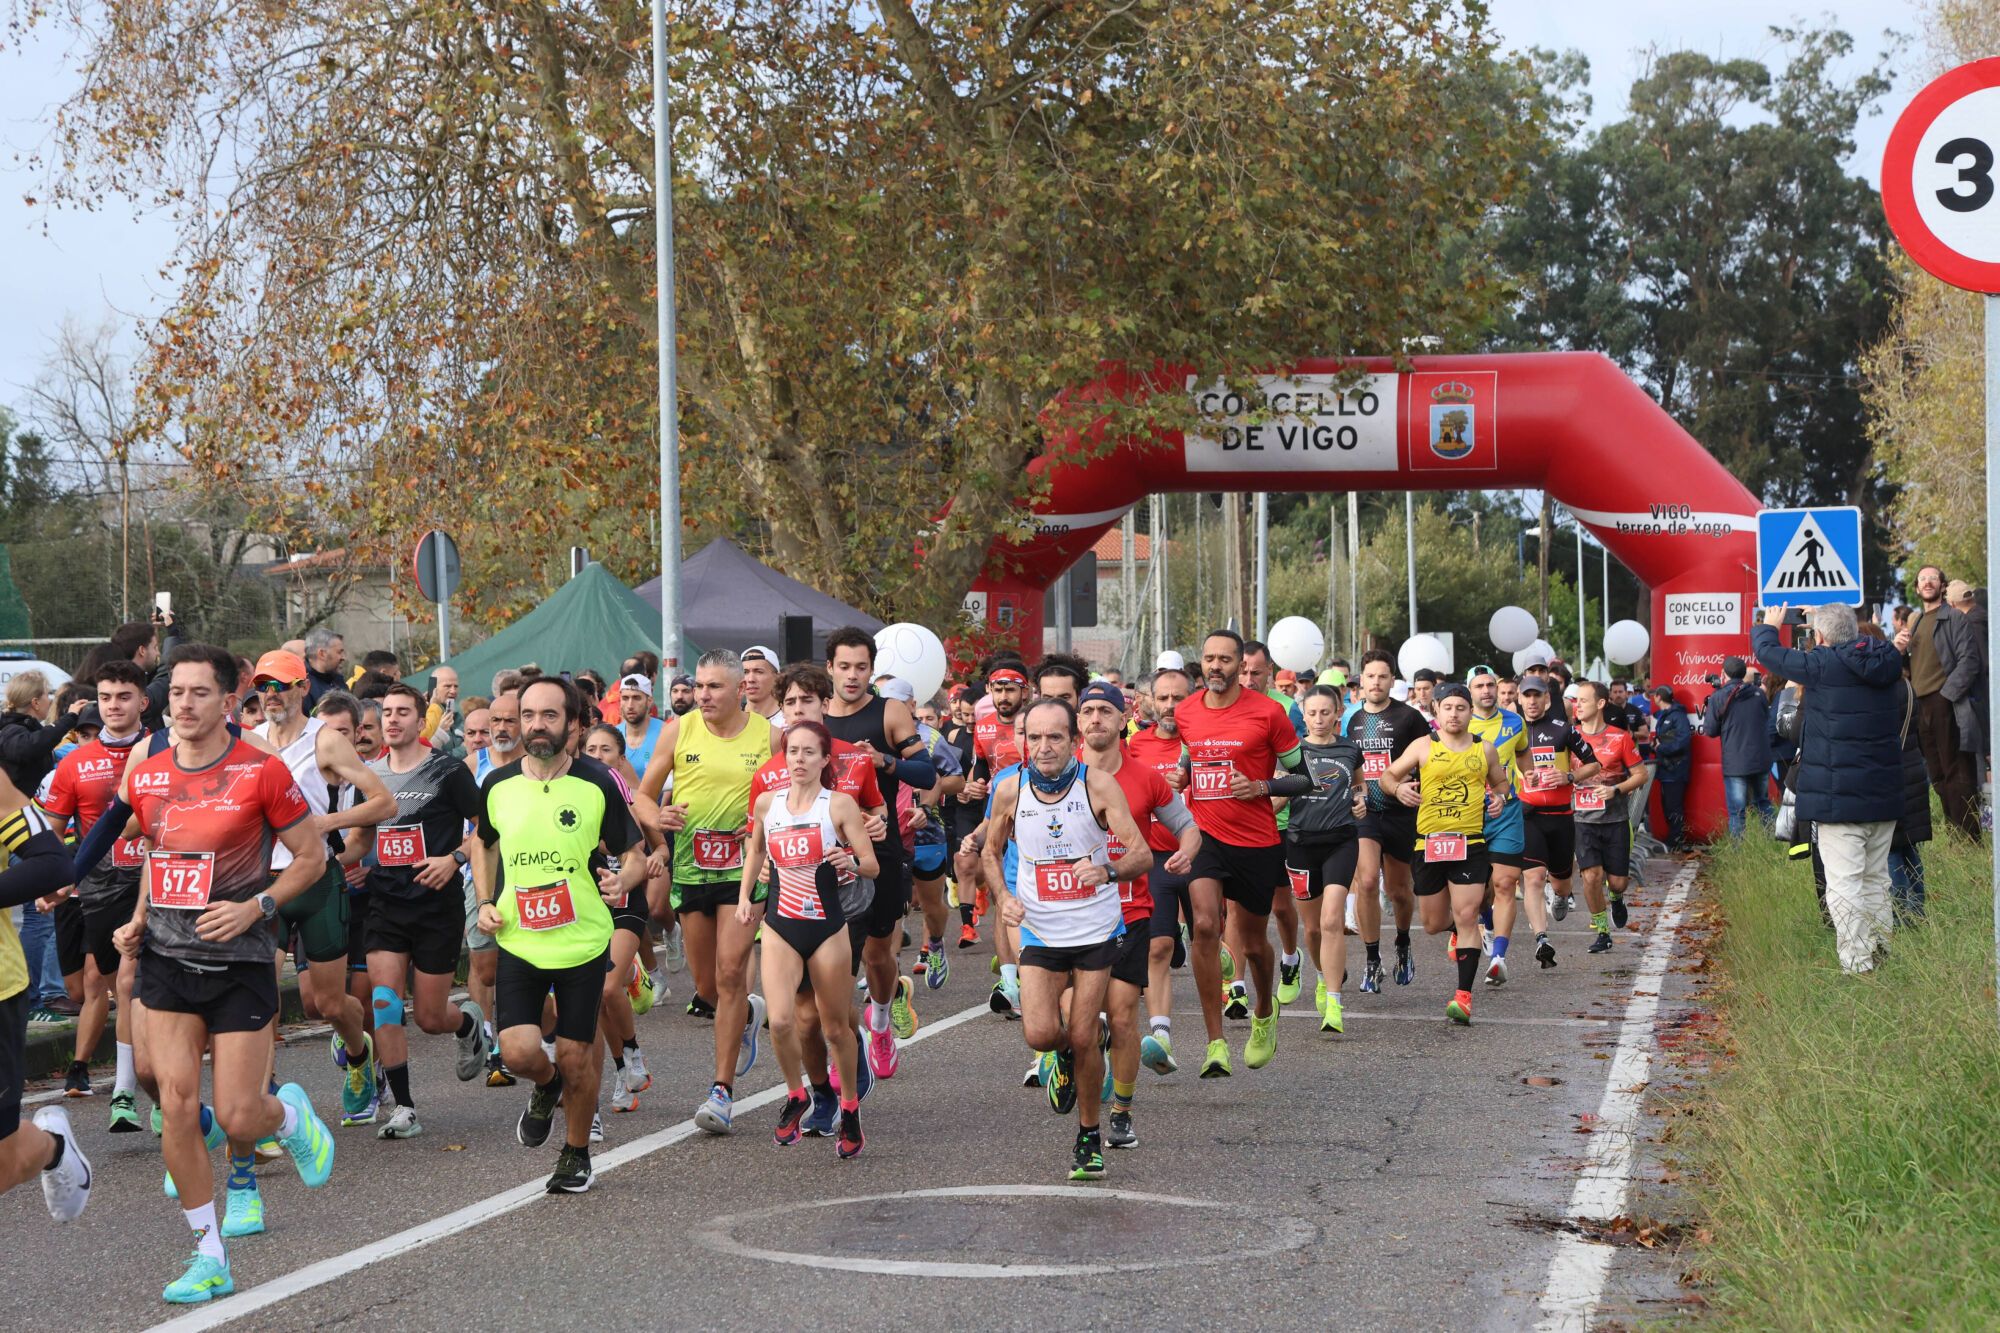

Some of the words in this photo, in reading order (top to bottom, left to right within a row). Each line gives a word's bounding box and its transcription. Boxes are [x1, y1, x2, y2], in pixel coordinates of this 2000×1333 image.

[1222, 425, 1264, 450] DE
[1277, 425, 1358, 450] VIGO
[1649, 504, 1696, 521] VIGO,
[1616, 520, 1661, 535] terreo
[1668, 520, 1687, 535] de
[1694, 522, 1732, 538] xogo
[1669, 601, 1734, 613] CONCELLO
[1675, 616, 1689, 626] DE
[1694, 614, 1726, 626] VIGO
[1675, 650, 1725, 665] Vivimos
[1212, 739, 1244, 747] Santander
[77, 760, 94, 774] LA
[96, 758, 114, 770] 21
[686, 754, 700, 762] DK
[134, 773, 150, 788] LA
[152, 772, 170, 786] 21
[760, 771, 779, 785] LA
[1195, 772, 1228, 789] 1072
[1580, 793, 1598, 804] 645
[383, 839, 414, 856] 458
[701, 841, 730, 859] 921
[778, 837, 810, 858] 168
[1434, 842, 1456, 854] 317
[162, 869, 201, 893] 672
[524, 896, 560, 920] 666
